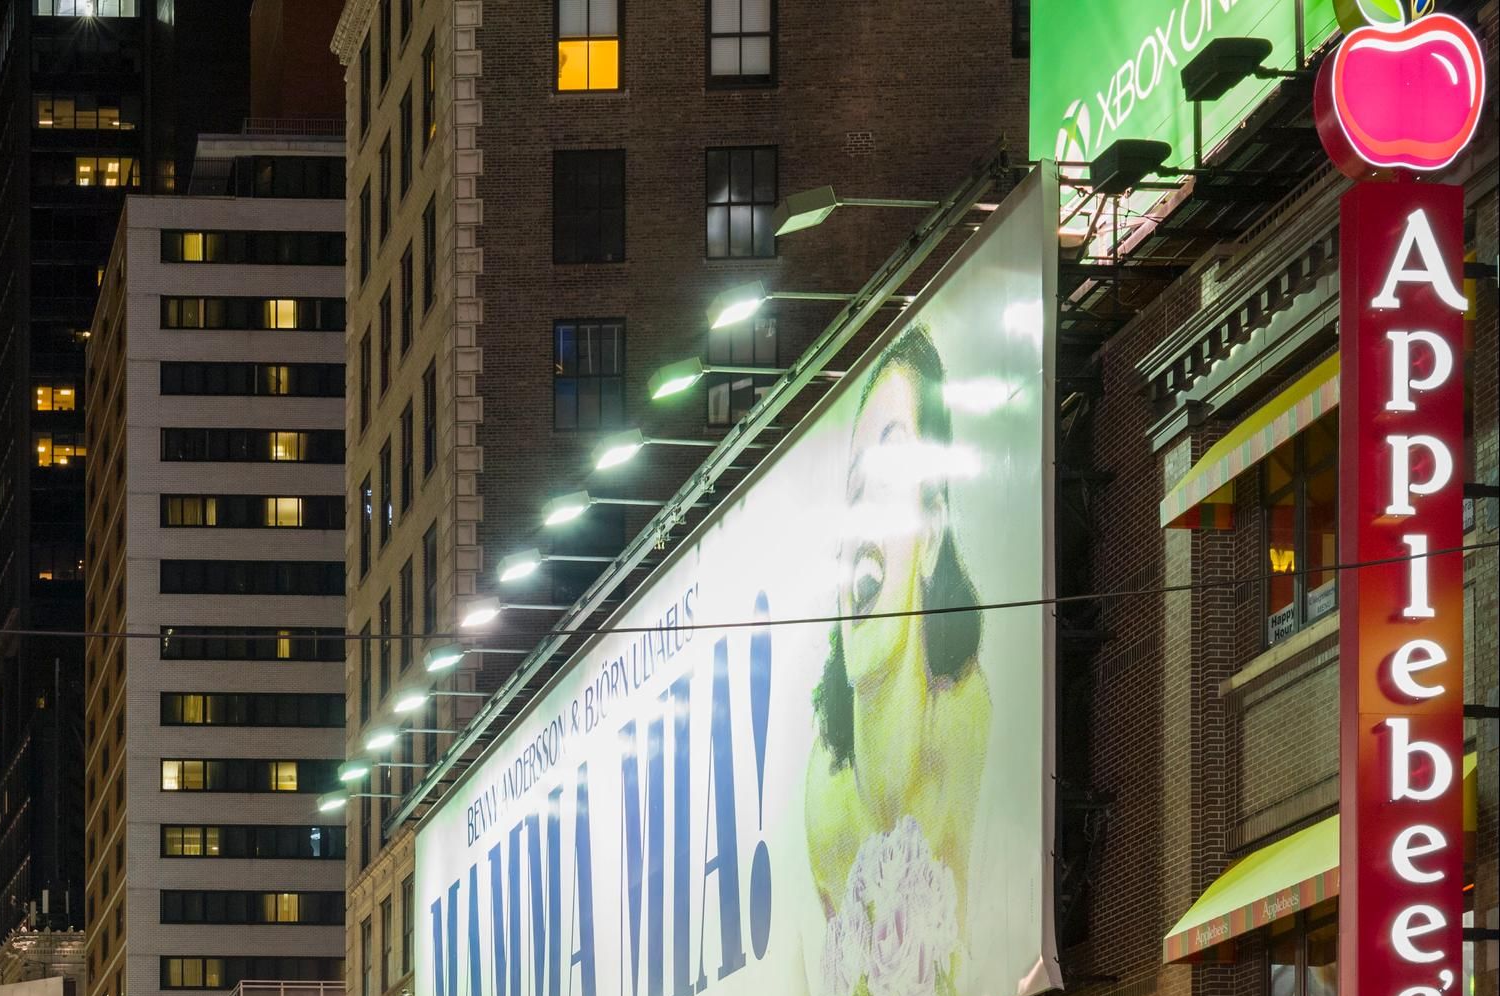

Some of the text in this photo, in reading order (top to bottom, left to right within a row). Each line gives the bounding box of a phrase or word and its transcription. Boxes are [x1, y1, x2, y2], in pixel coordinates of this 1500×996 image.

[1093, 25, 1178, 147] XBOX
[1271, 606, 1295, 628] Happy
[1274, 623, 1293, 641] Hour
[467, 786, 498, 848] BENNY
[500, 713, 567, 807] ANDERSSON
[570, 700, 580, 736] &
[584, 654, 629, 734] BJÖRN
[1262, 892, 1299, 919] Applebee's
[1195, 922, 1230, 945] Applebee's
